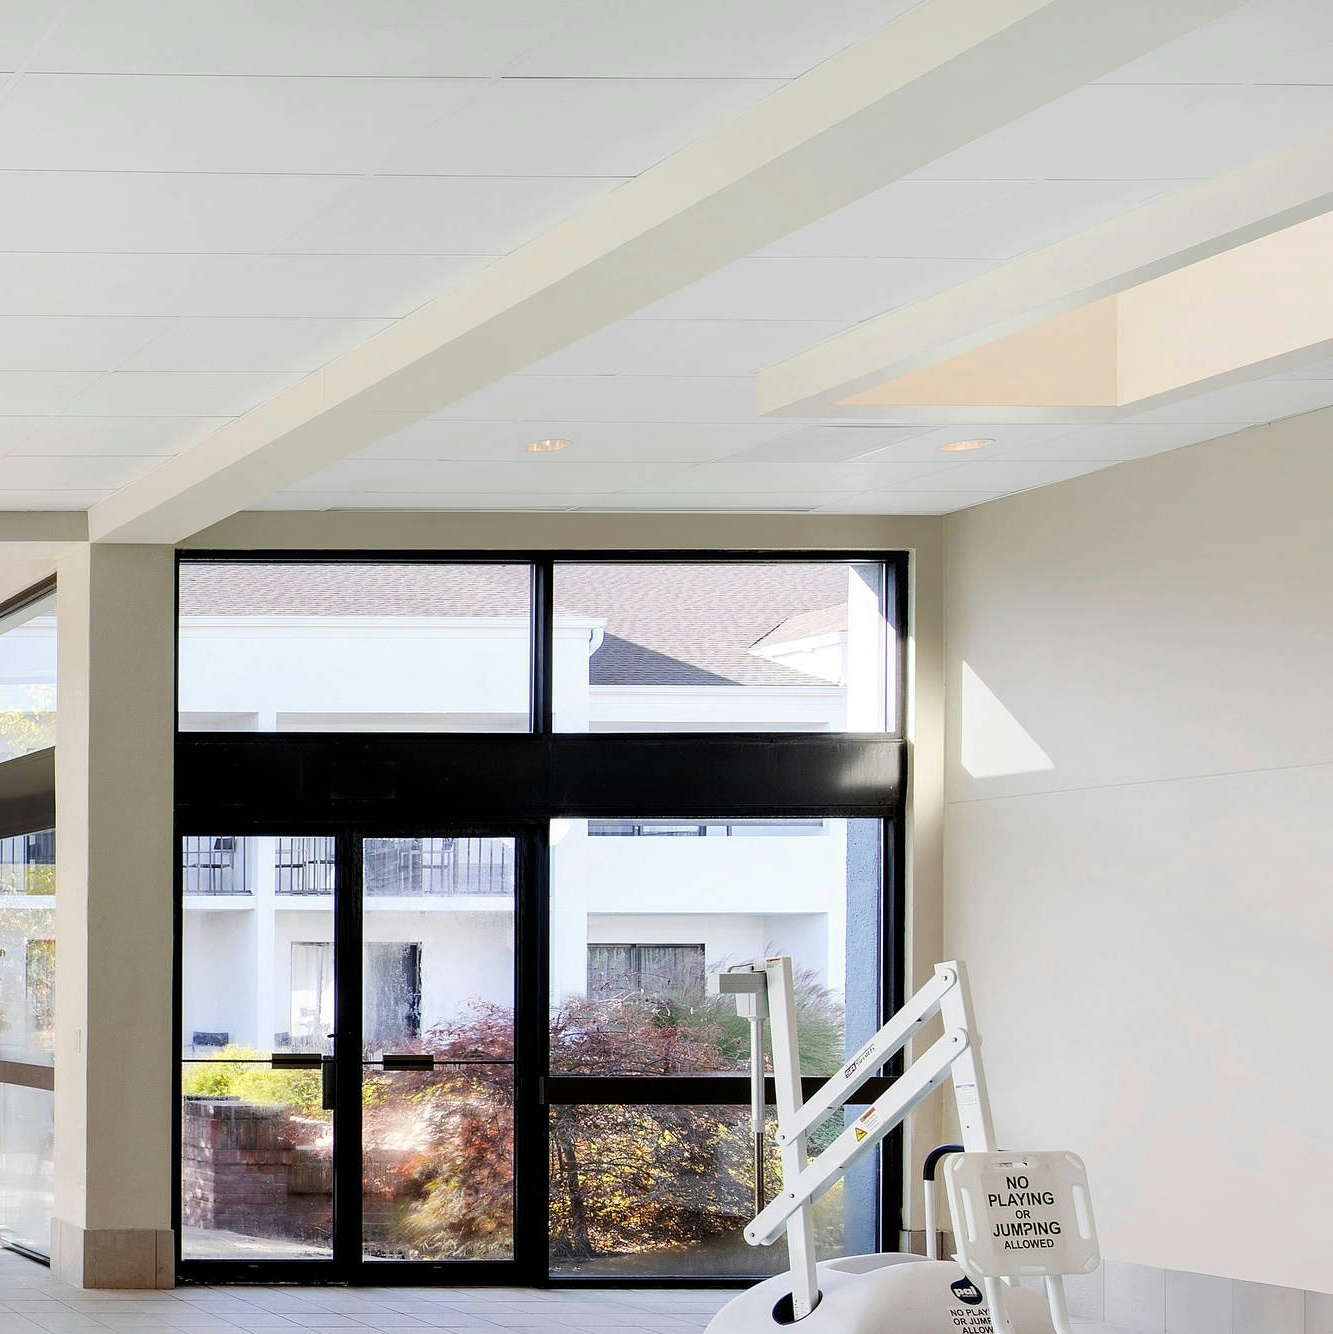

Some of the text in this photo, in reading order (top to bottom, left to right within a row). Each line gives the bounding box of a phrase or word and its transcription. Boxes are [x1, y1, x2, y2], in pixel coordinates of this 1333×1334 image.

[1006, 1176, 1029, 1189] NO
[988, 1192, 1054, 1207] PLAYING
[1015, 1210, 1031, 1219] OR
[993, 1221, 1061, 1237] JUMPING
[1004, 1239, 1054, 1249] ALLOWED
[954, 1286, 977, 1297] pal
[966, 1308, 990, 1316] PLAY
[970, 1317, 992, 1325] JUMP
[963, 1326, 993, 1334] ALLOW
